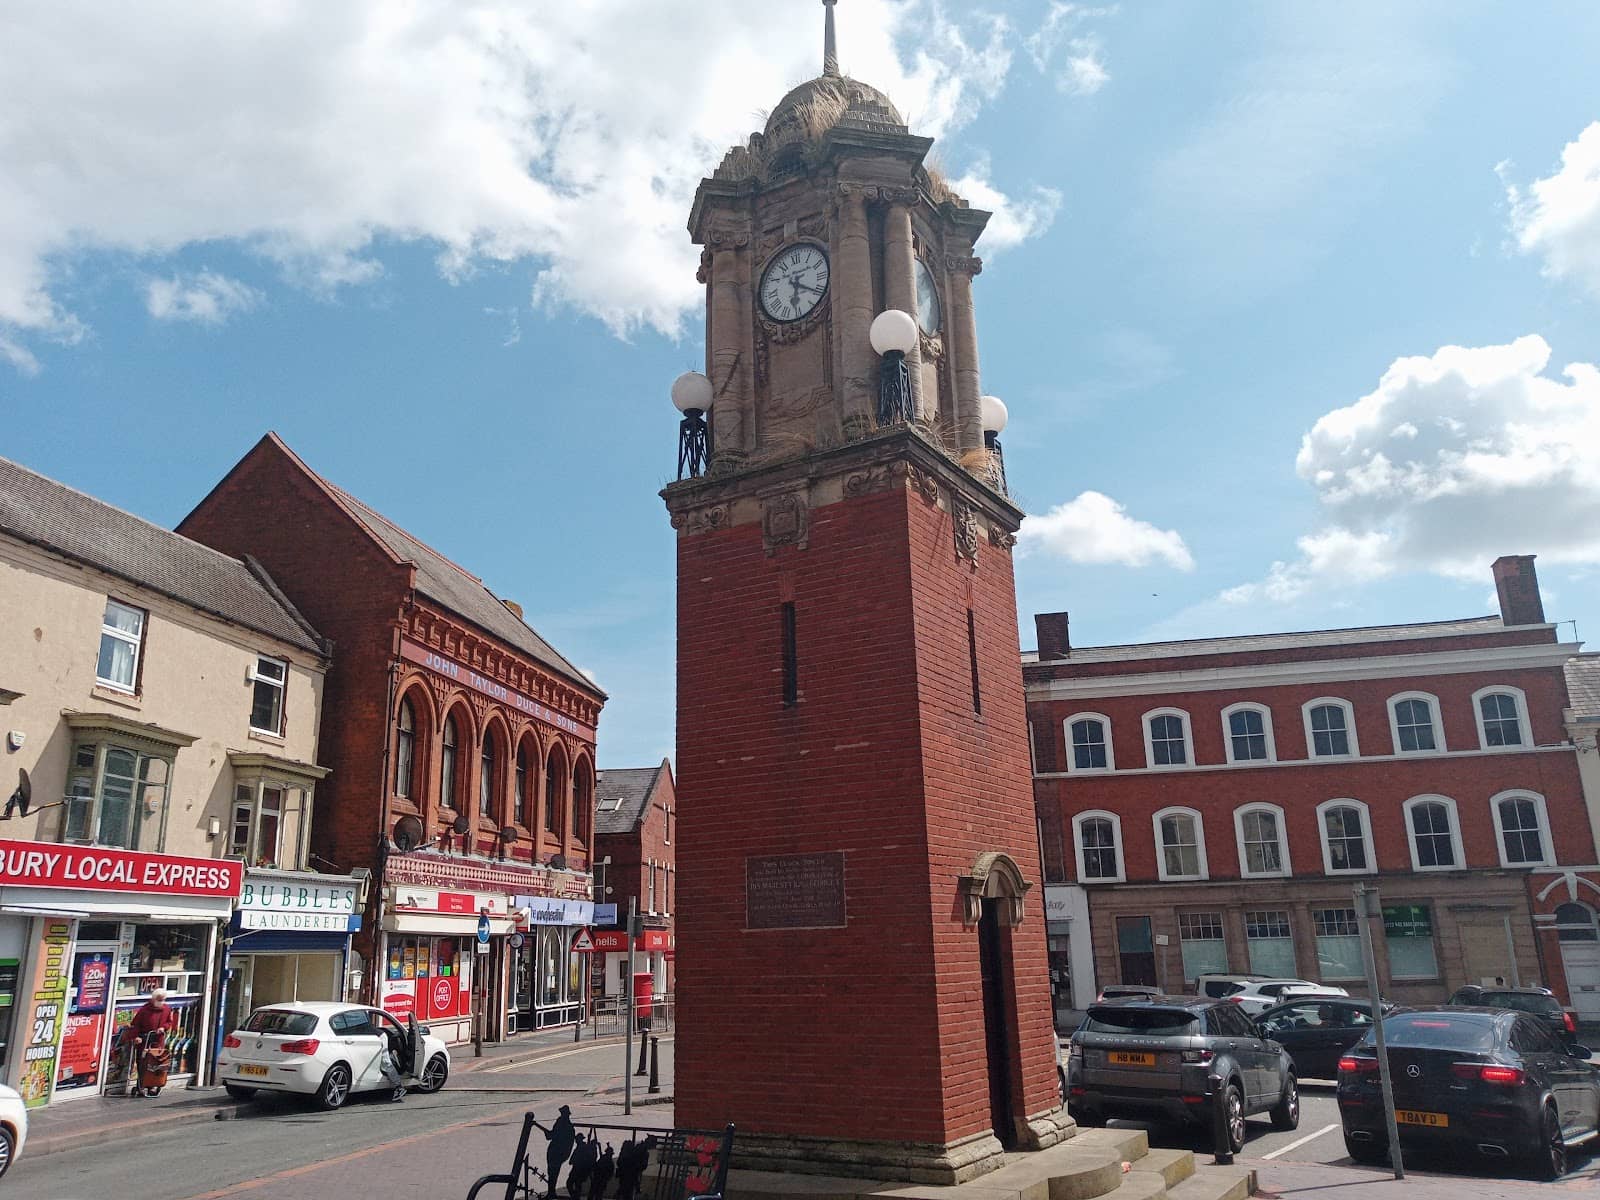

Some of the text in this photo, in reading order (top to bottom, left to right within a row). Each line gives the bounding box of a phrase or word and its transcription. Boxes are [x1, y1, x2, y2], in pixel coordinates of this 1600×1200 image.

[426, 652, 578, 733] JOHN TAYLOR DUCE & SONS
[63, 855, 138, 884] LOCAL
[143, 862, 231, 890] EXPRESS
[242, 884, 354, 909] BUBBLES
[435, 994, 449, 1002] OFFICE
[438, 986, 448, 995] POST
[36, 1004, 58, 1018] OPEN
[31, 1019, 55, 1044] 24
[25, 1046, 55, 1061] HOURS
